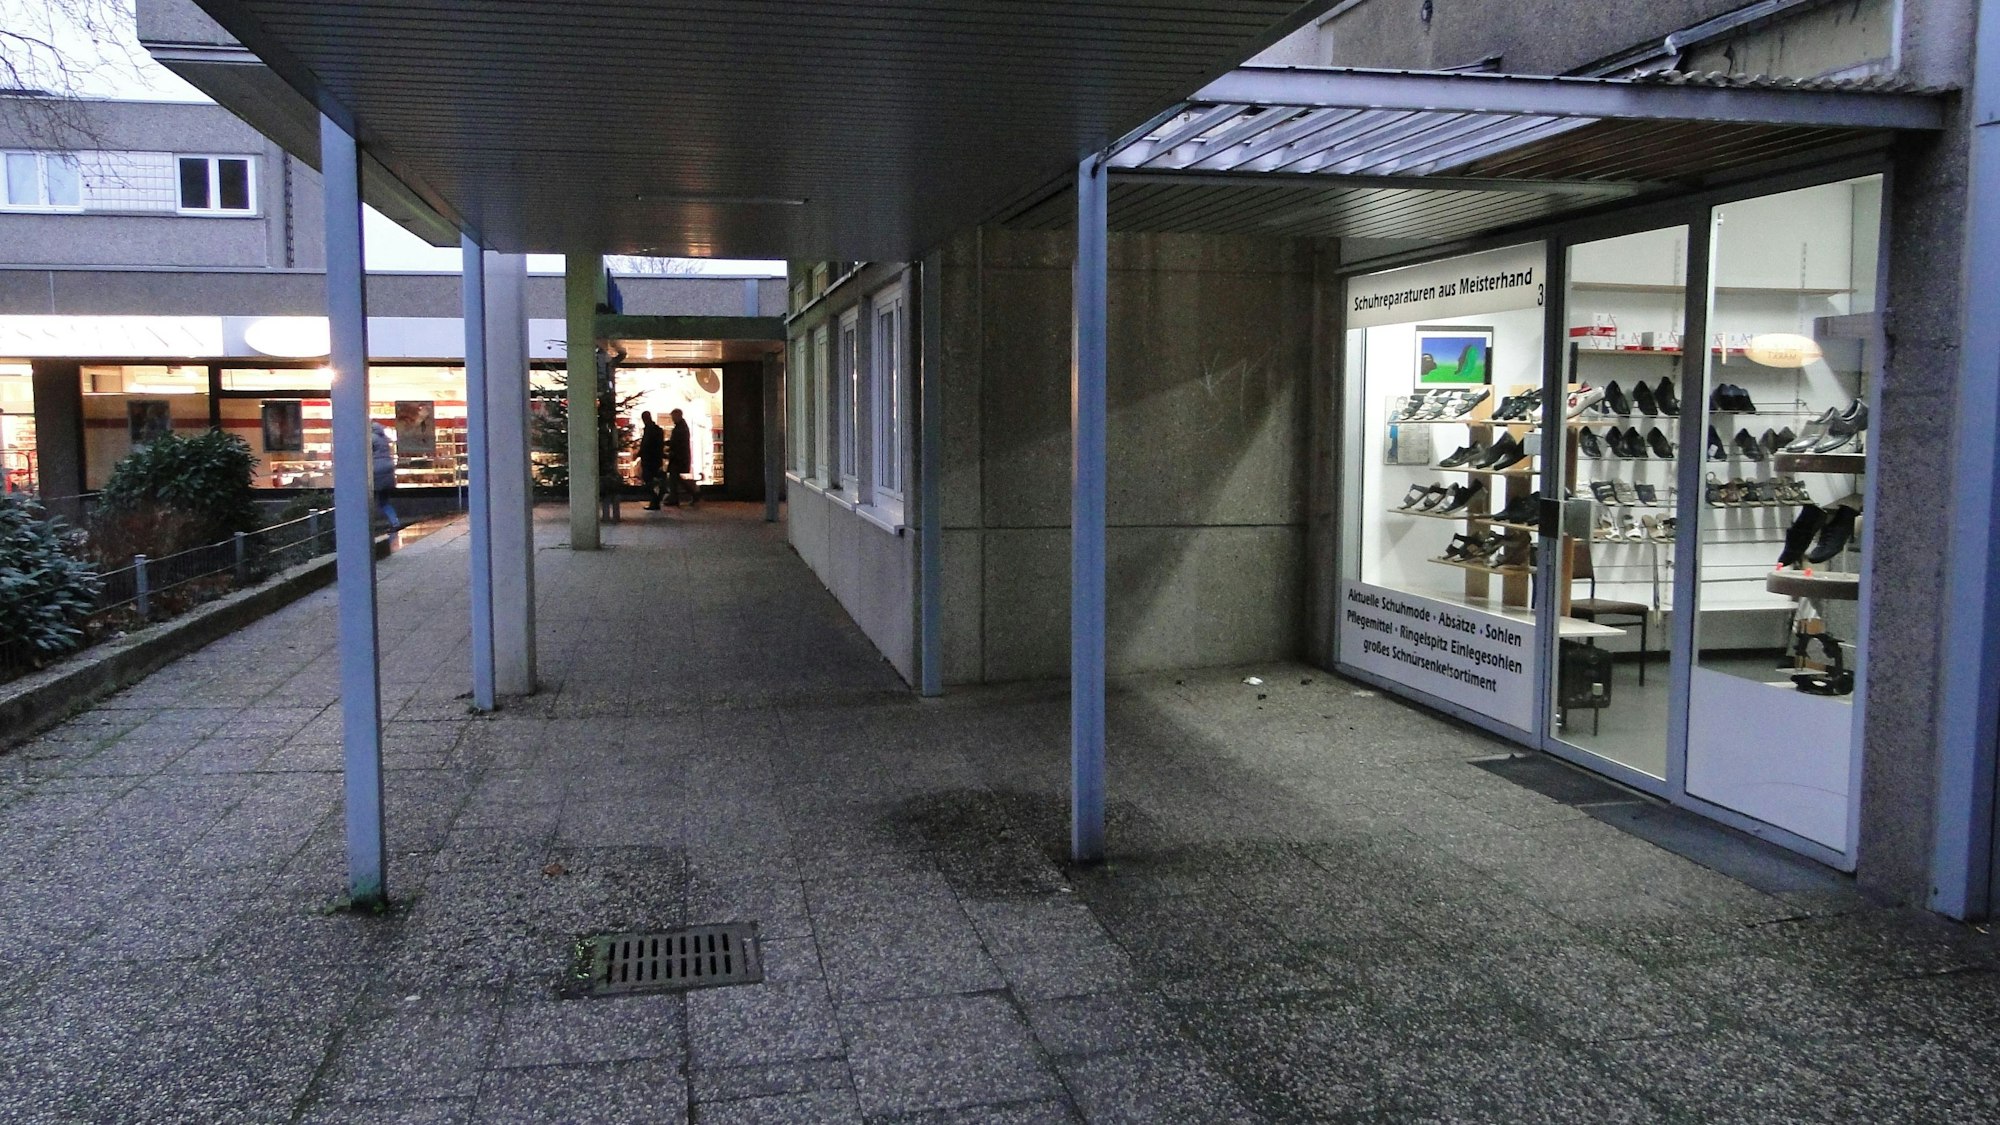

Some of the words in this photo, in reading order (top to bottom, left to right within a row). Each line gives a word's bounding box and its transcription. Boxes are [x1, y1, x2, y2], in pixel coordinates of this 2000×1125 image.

[1354, 286, 1436, 311] Schuhreparaturen
[1438, 281, 1456, 298] aus
[1459, 267, 1533, 294] Meisterhand
[1537, 283, 1544, 306] 3
[1347, 588, 1380, 607] Aktuelle
[1381, 596, 1431, 622] Schuhmode
[1438, 611, 1476, 634] Absätze
[1485, 624, 1522, 647] Sohlen
[1347, 609, 1393, 634] Pflegemittel
[1400, 626, 1448, 651] Ringelspitz
[1451, 639, 1522, 674] Einlegesohlen
[1363, 638, 1390, 657] großes
[1392, 647, 1497, 692] Schnürsenkelsortiment
